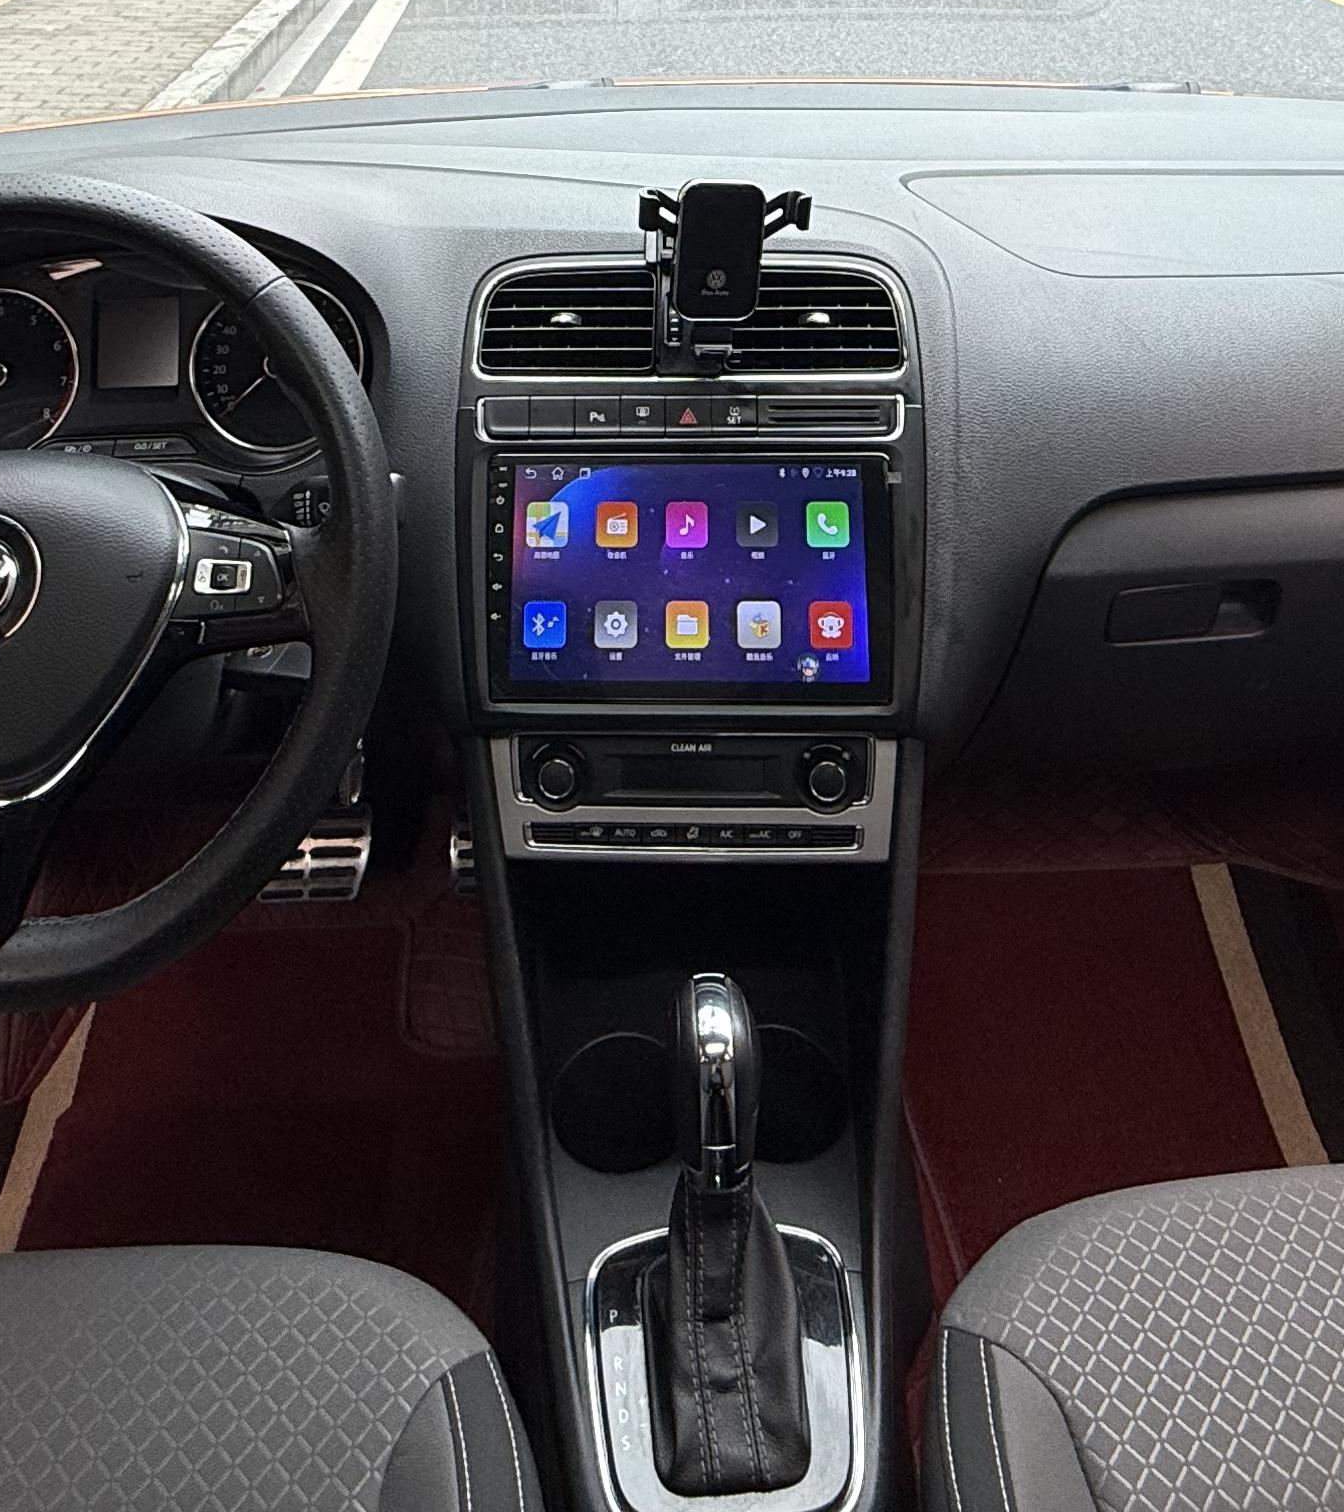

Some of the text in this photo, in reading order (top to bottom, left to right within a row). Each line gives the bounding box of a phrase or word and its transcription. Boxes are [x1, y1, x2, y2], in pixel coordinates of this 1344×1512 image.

[670, 743, 696, 753] CLEAN
[614, 828, 636, 837] AUTO
[609, 1309, 619, 1324] P
[613, 1356, 623, 1371] R
[615, 1381, 627, 1396] N
[618, 1408, 629, 1424] D
[621, 1435, 631, 1451] S
